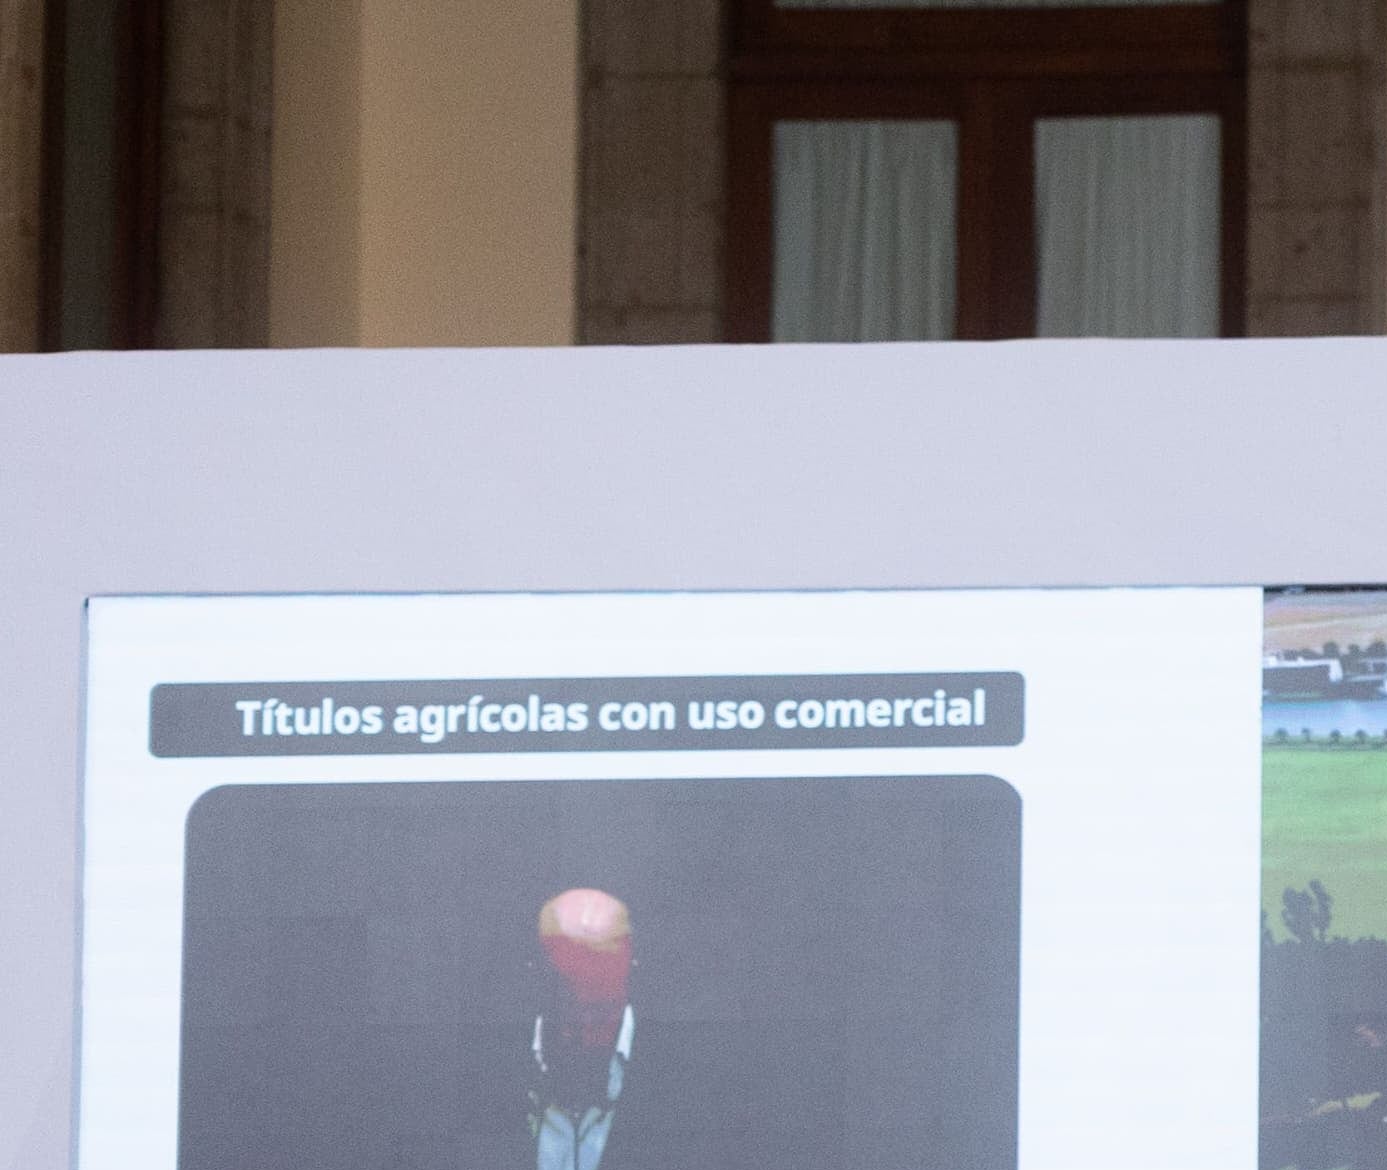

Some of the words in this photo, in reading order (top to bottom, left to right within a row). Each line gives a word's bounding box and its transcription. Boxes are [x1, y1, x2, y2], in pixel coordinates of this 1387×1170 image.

[237, 696, 384, 737] Títulos
[392, 693, 589, 742] agrícolas
[598, 698, 677, 734] con
[688, 698, 762, 731] uso
[773, 690, 987, 731] comercial
